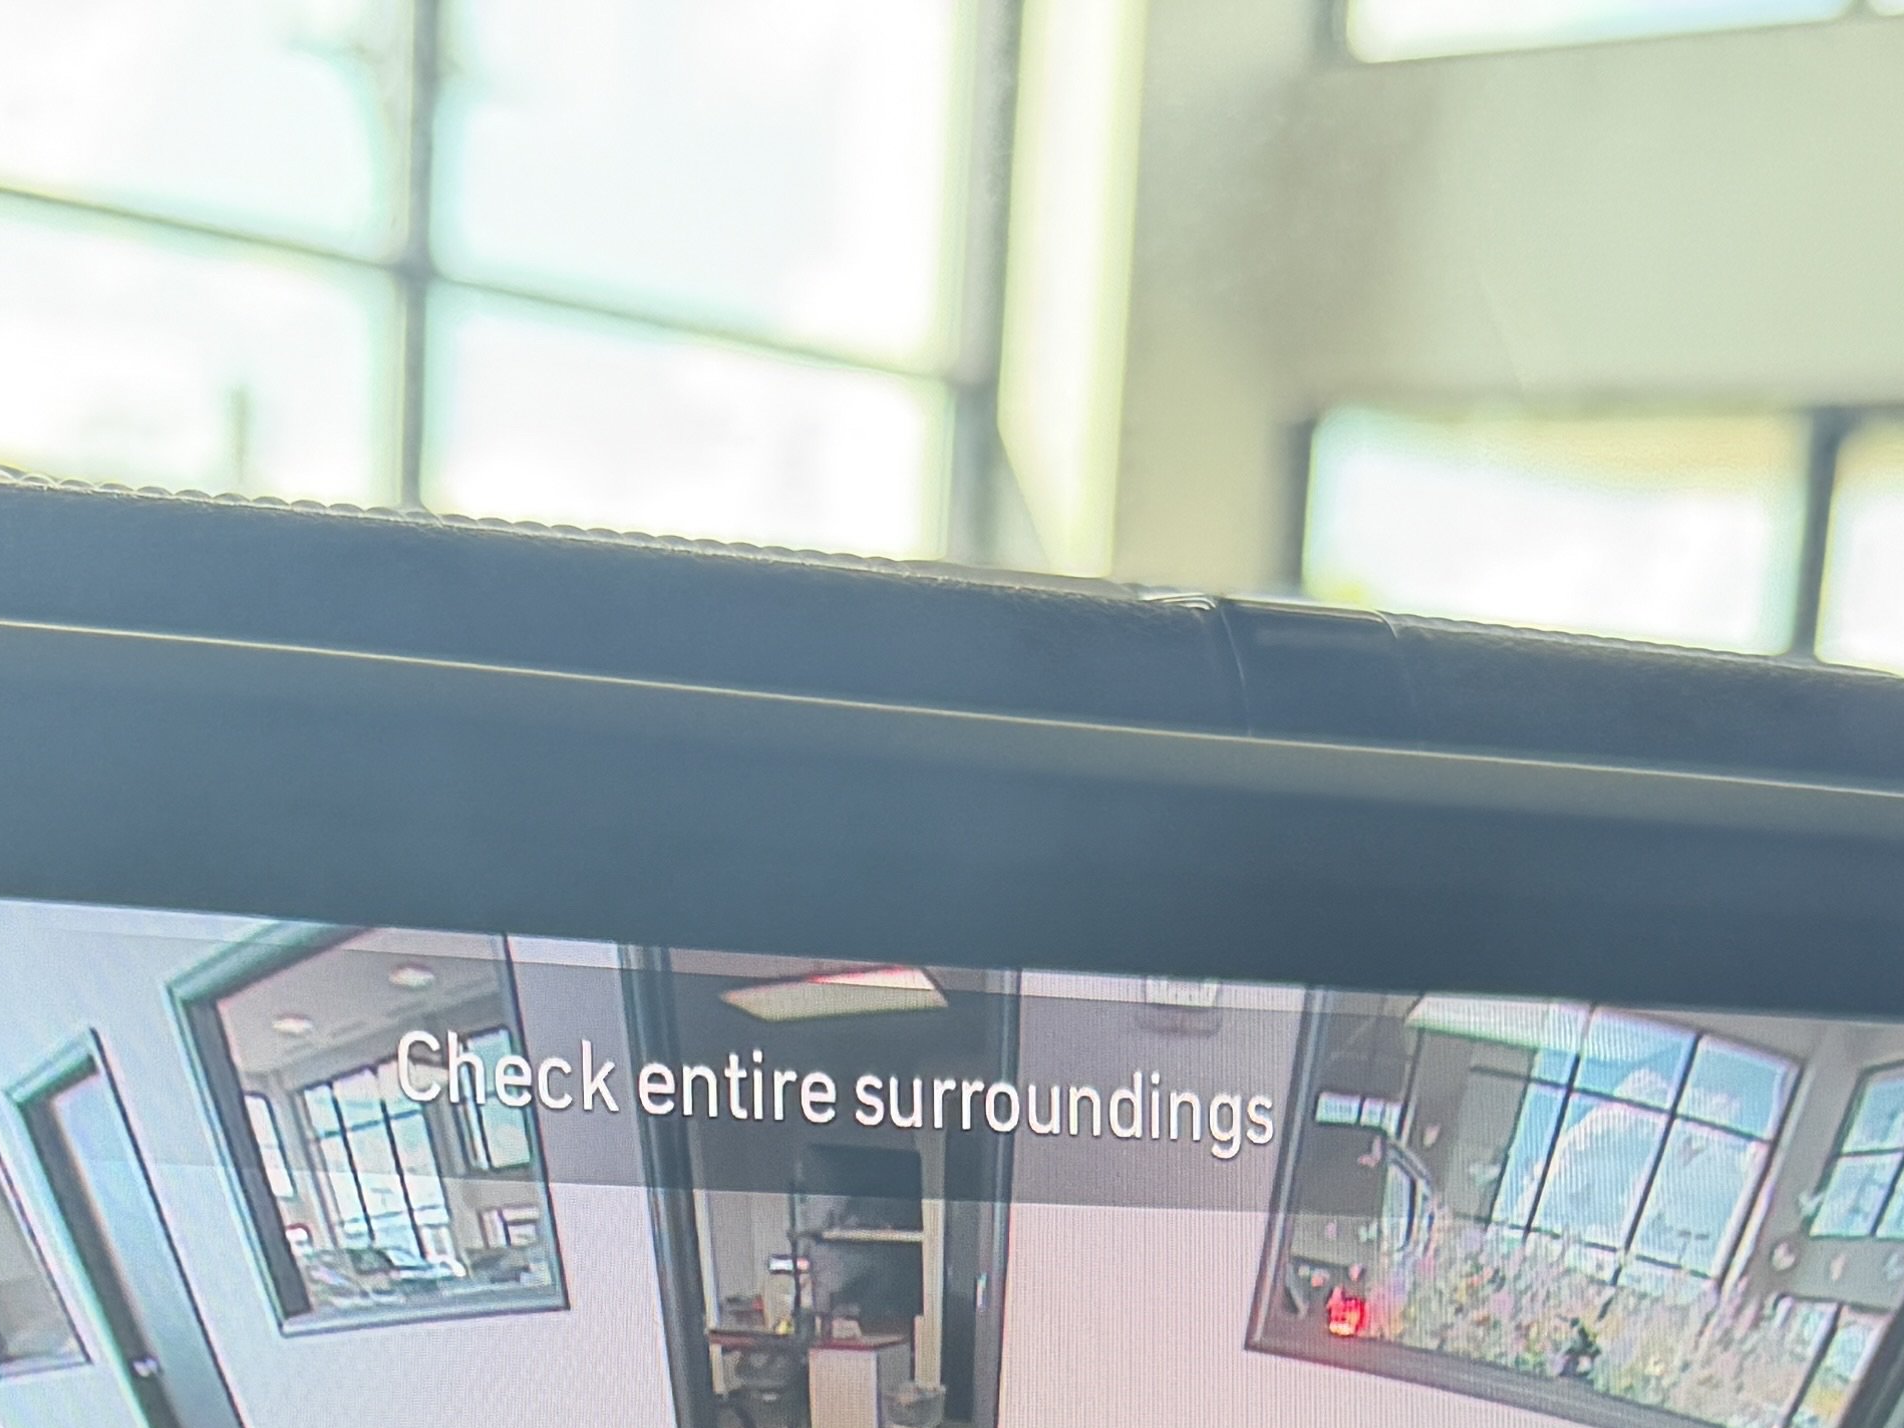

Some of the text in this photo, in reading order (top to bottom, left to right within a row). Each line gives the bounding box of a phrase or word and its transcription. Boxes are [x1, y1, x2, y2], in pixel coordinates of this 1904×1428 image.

[396, 1029, 1274, 1160] Check entire surroundings
